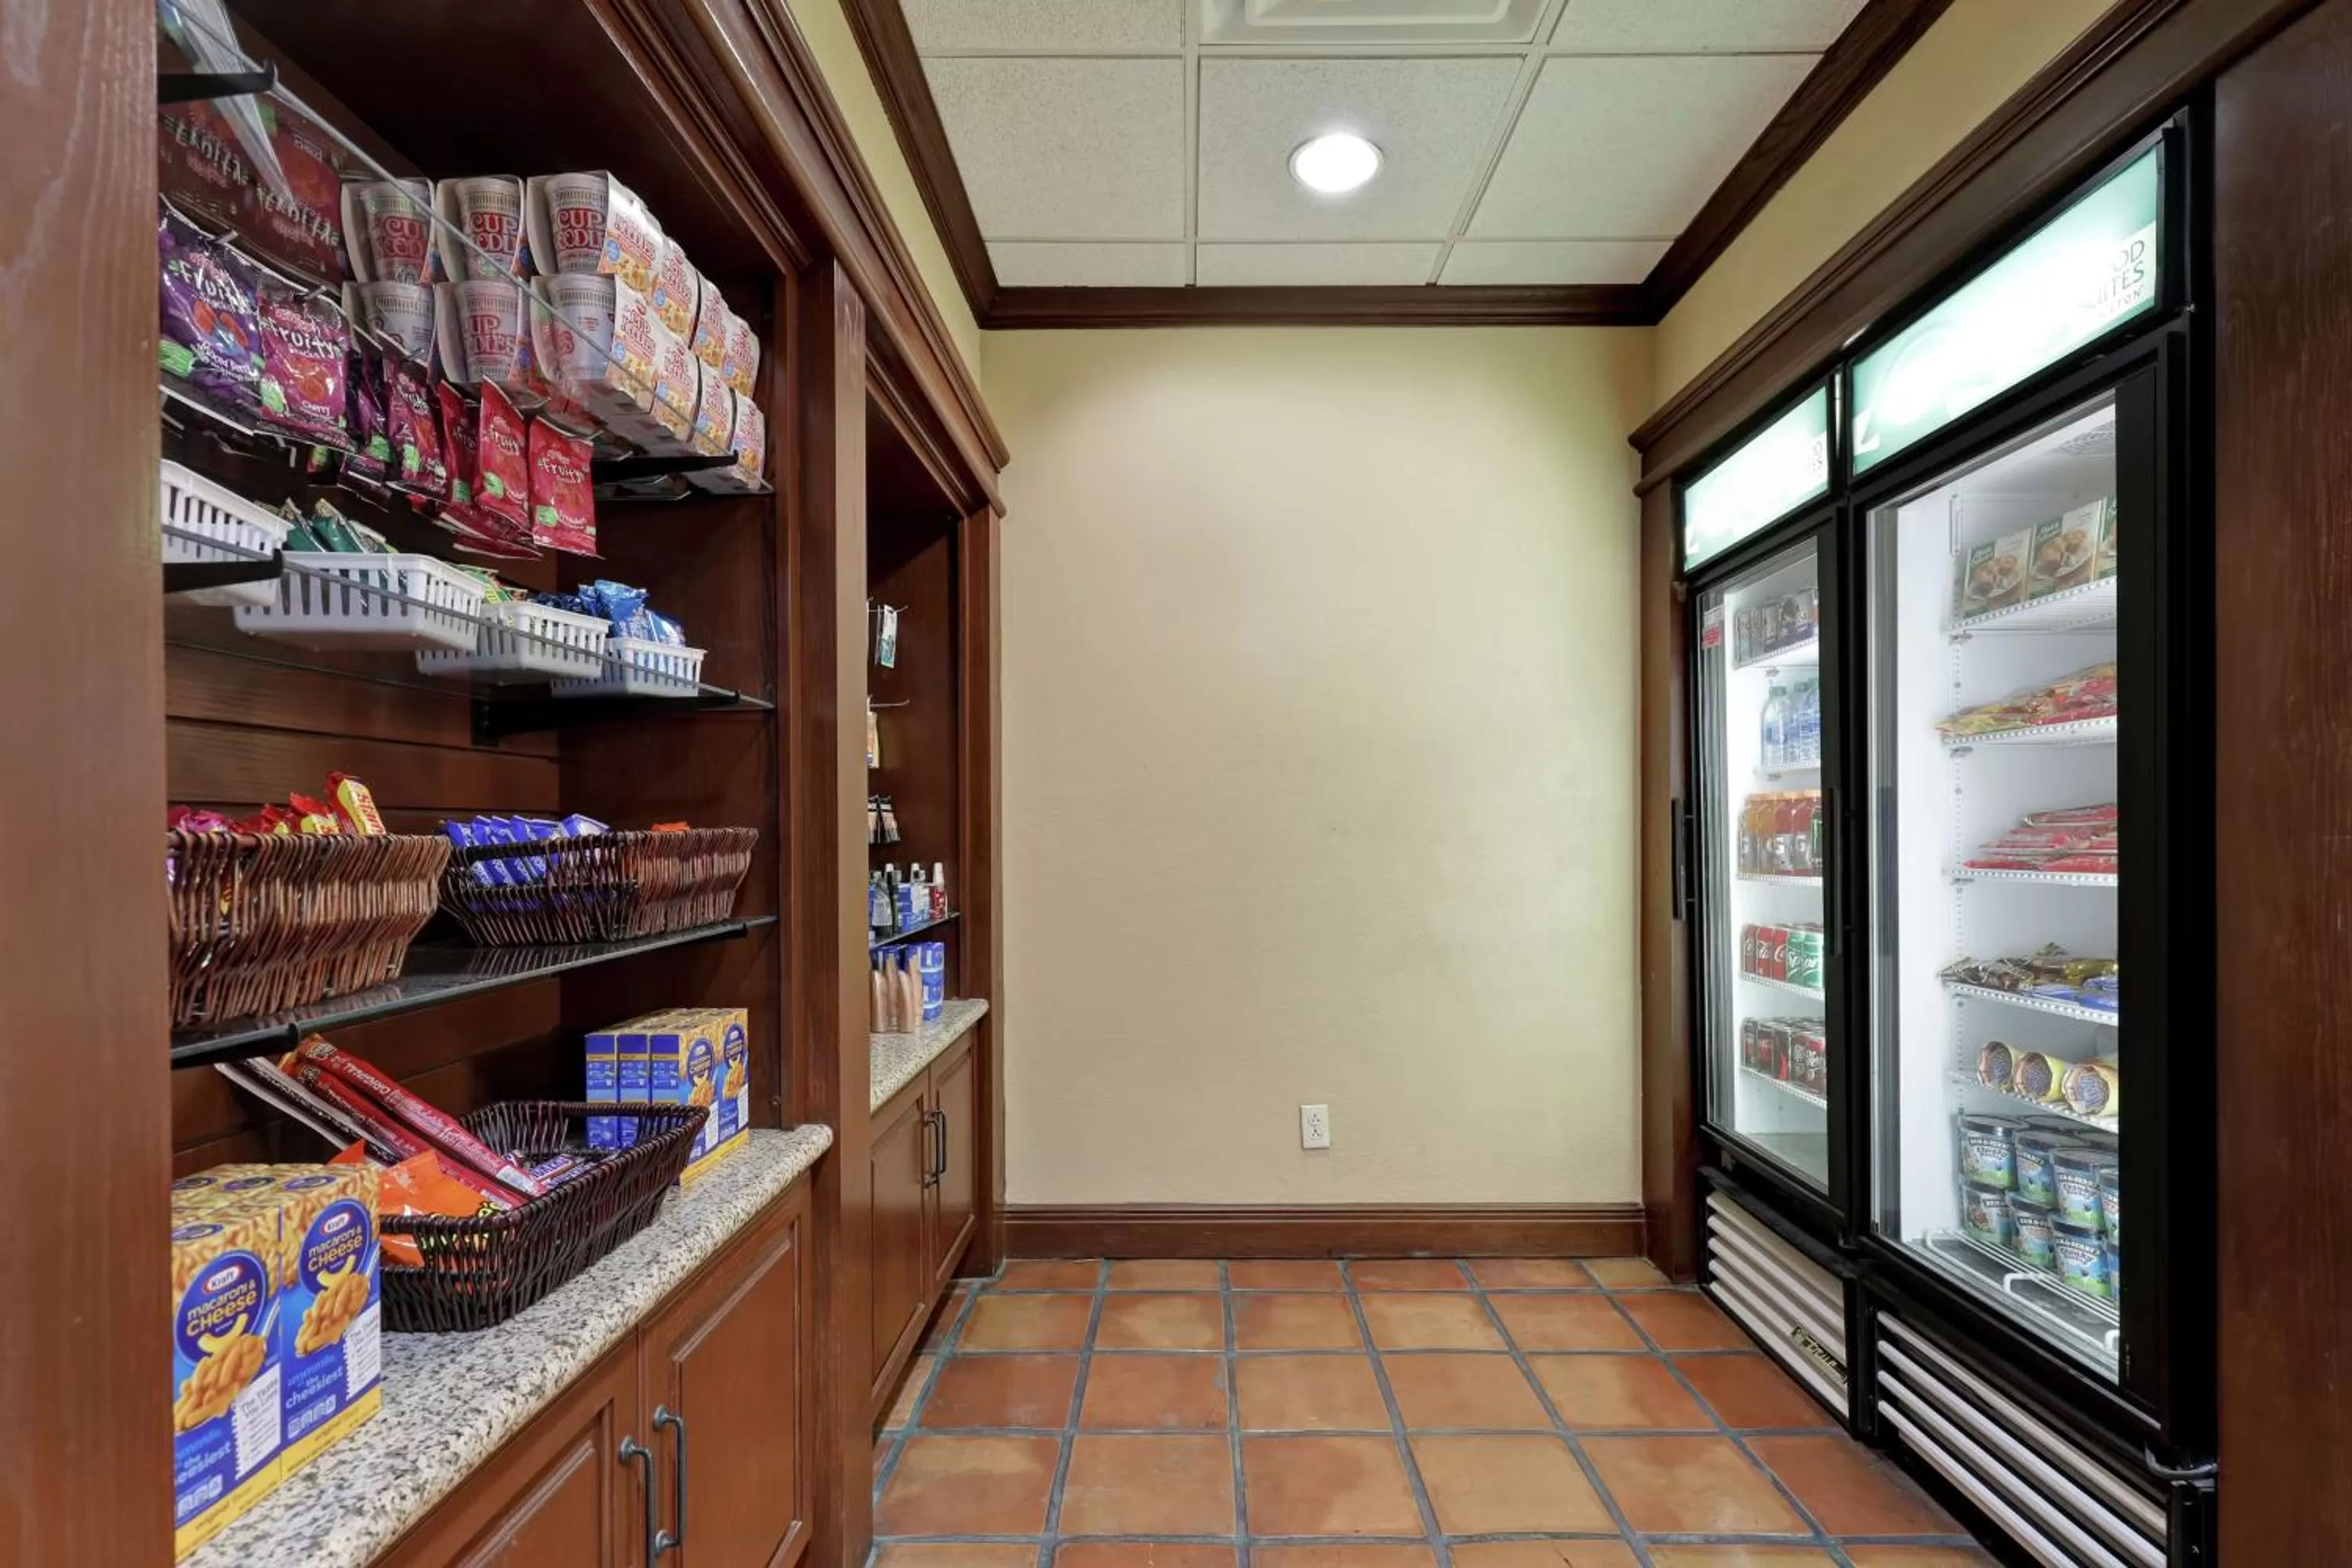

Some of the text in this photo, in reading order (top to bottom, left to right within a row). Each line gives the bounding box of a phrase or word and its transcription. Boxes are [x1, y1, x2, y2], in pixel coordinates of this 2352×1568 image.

[385, 217, 426, 238] CU
[470, 212, 518, 234] CUP
[557, 209, 604, 230] CUP
[469, 314, 501, 335] UP
[327, 1216, 347, 1232] Kraft
[308, 1229, 354, 1258] macaroni
[211, 1271, 234, 1288] Kraft
[187, 1283, 248, 1320] macaroni
